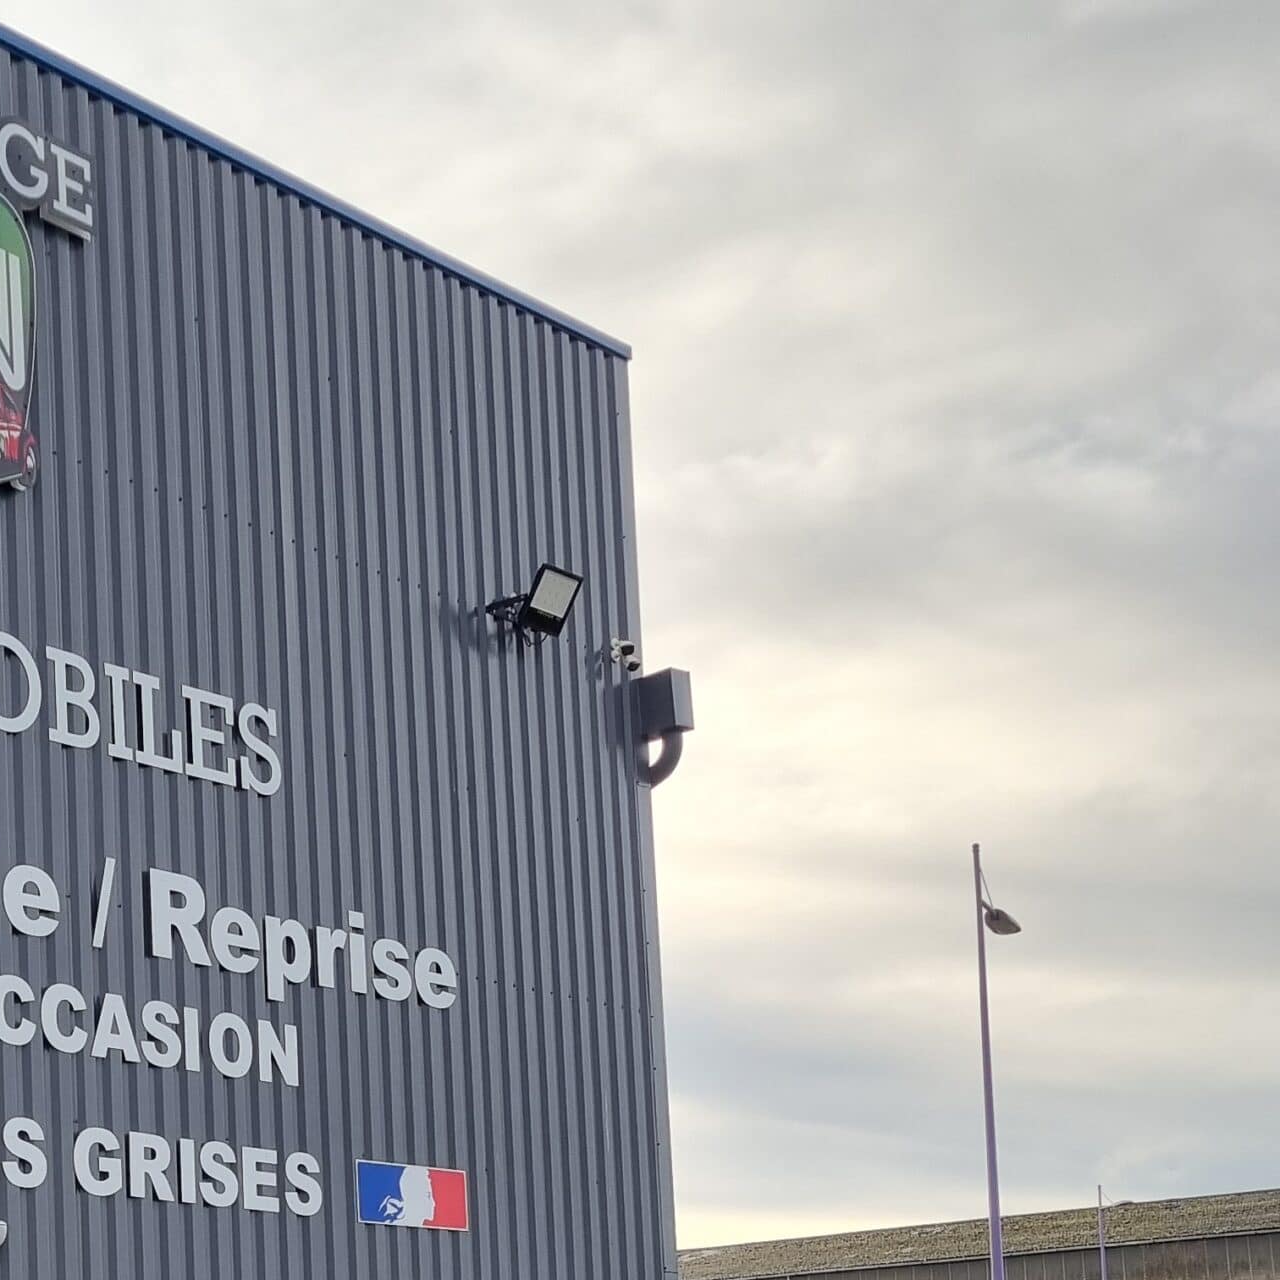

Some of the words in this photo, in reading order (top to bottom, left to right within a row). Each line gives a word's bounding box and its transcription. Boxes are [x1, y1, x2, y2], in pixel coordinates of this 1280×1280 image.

[92, 856, 116, 948] /
[149, 867, 458, 1009] Reprise
[73, 1127, 323, 1216] GRISES
